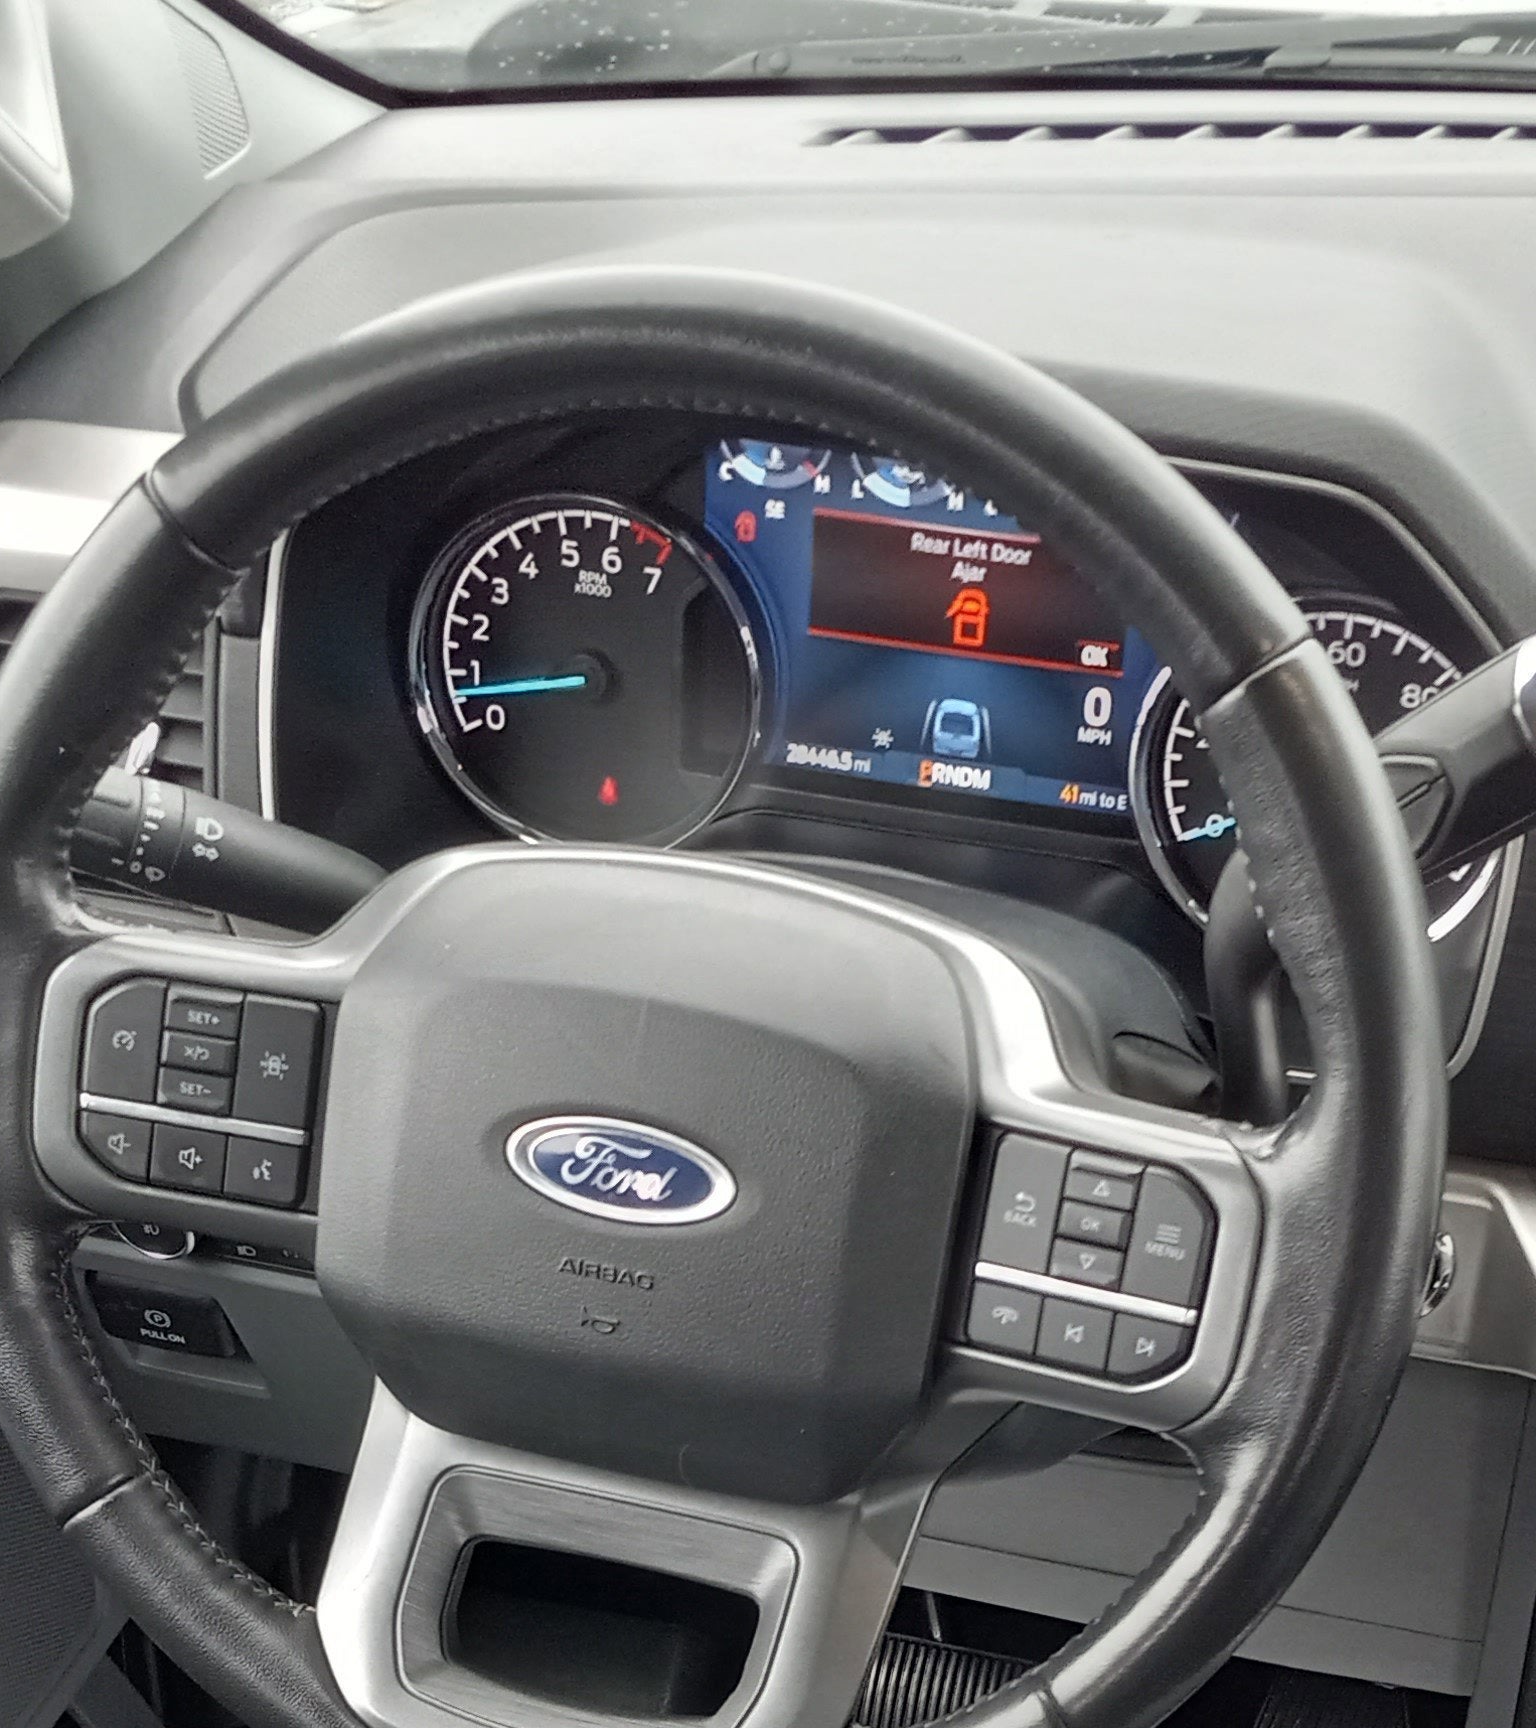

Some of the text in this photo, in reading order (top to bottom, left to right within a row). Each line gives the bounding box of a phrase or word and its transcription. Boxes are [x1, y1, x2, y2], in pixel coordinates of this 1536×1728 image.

[561, 540, 580, 567] 5
[602, 547, 622, 573] 6
[911, 532, 1032, 566] Rear Left Door
[519, 552, 539, 579] 4
[579, 570, 607, 586] RPM
[951, 560, 987, 584] Ajar
[492, 578, 509, 604] 3
[575, 582, 612, 598] x1000
[643, 567, 662, 594] 7
[472, 614, 490, 641] 2
[1081, 644, 1109, 668] OK
[1327, 640, 1366, 667] 60
[470, 660, 480, 686] 1
[486, 704, 505, 730] 0
[1084, 687, 1112, 726] 0
[1077, 725, 1112, 746] MPH
[854, 758, 871, 773] mi
[1059, 782, 1127, 811] 41 mi to E
[560, 1135, 678, 1202] Ford
[1003, 1209, 1037, 1228] BACK
[1080, 1218, 1099, 1232] OK
[559, 1257, 655, 1290] AIRBAG
[140, 1327, 186, 1344] PULL ON
